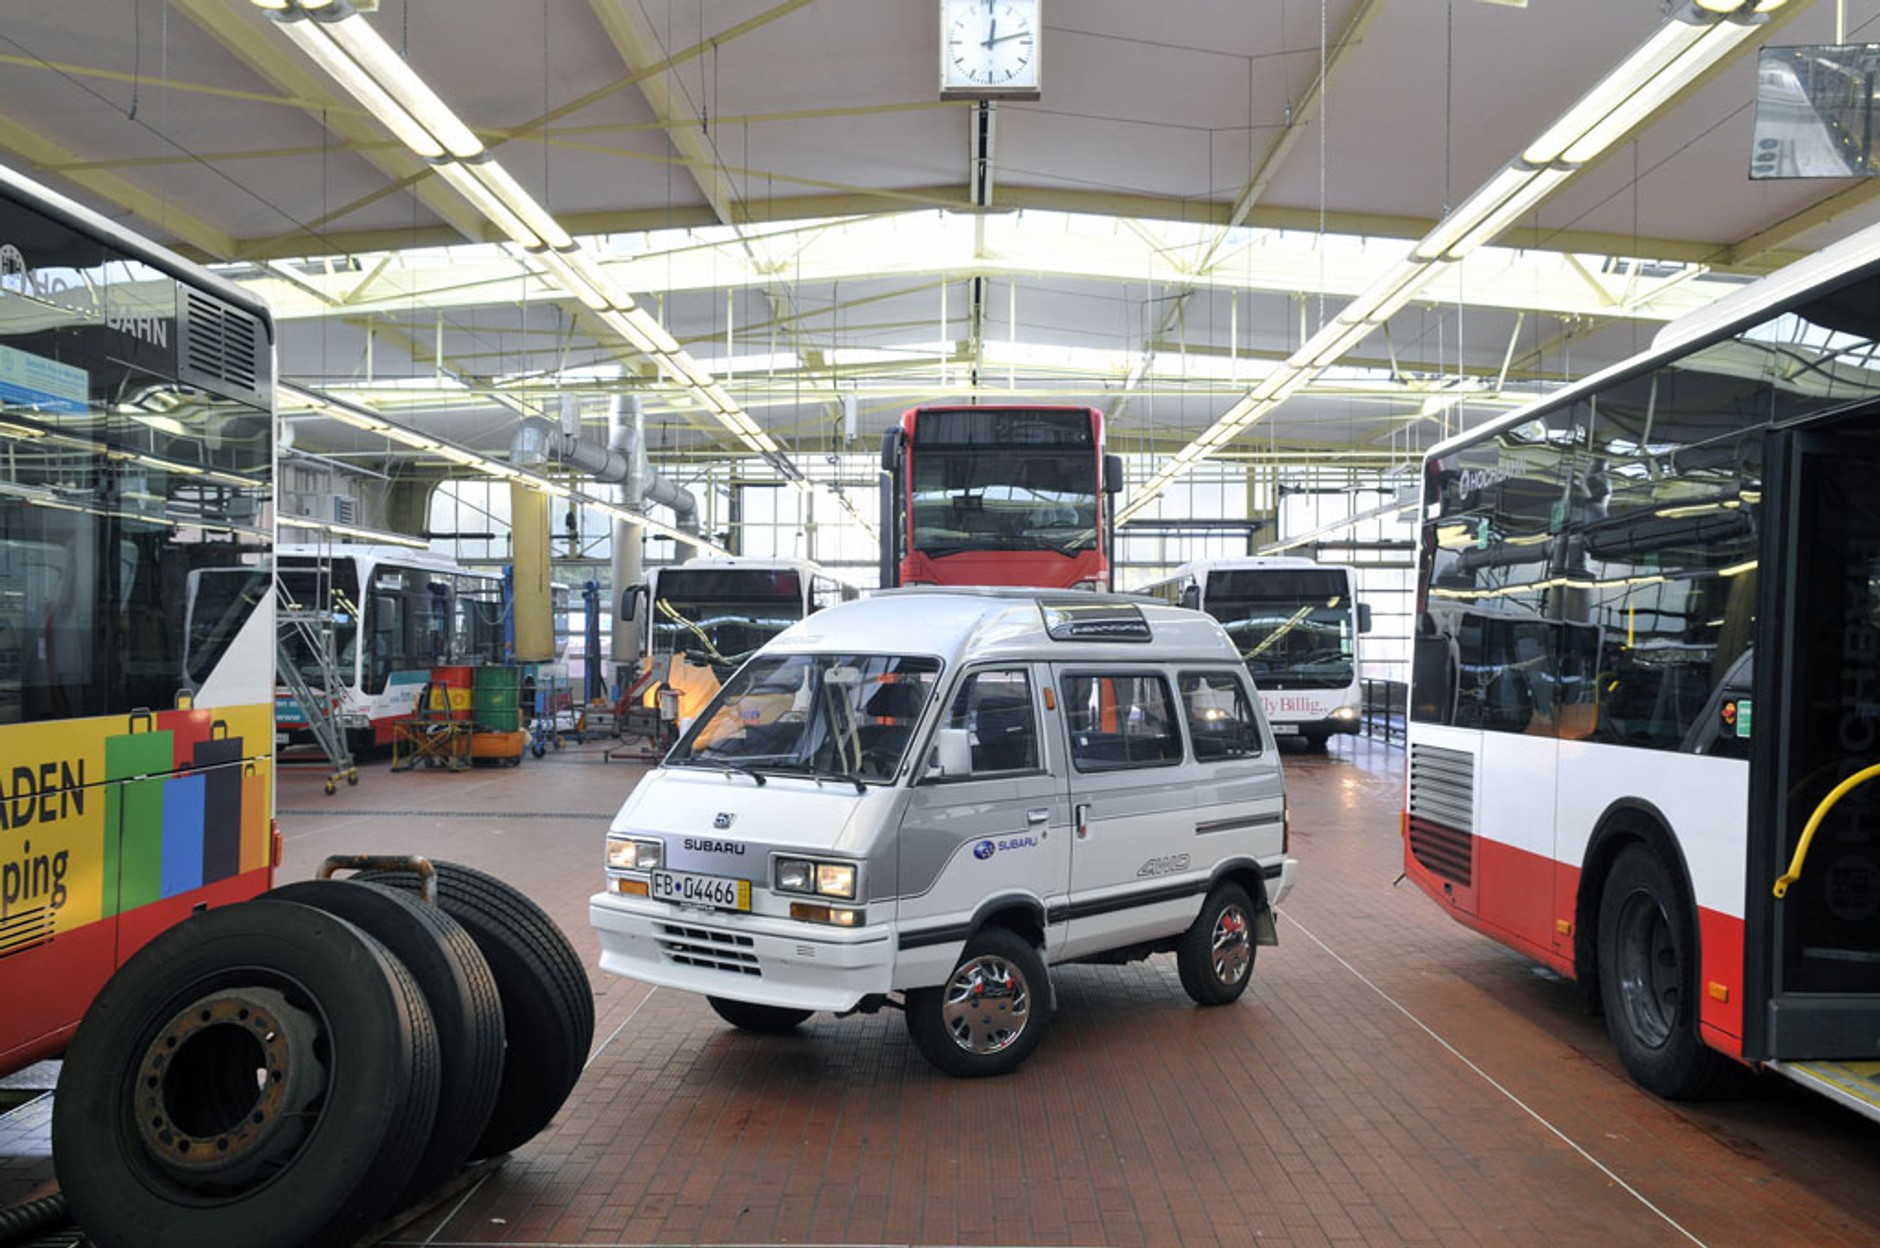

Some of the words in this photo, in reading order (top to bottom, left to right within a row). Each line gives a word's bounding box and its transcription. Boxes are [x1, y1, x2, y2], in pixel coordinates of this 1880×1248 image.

[1471, 457, 1527, 490] HOCHBHN
[684, 838, 745, 856] SUBARU
[998, 836, 1039, 851] SUBARU
[1136, 853, 1191, 877] 4WD
[684, 877, 735, 905] 04466
